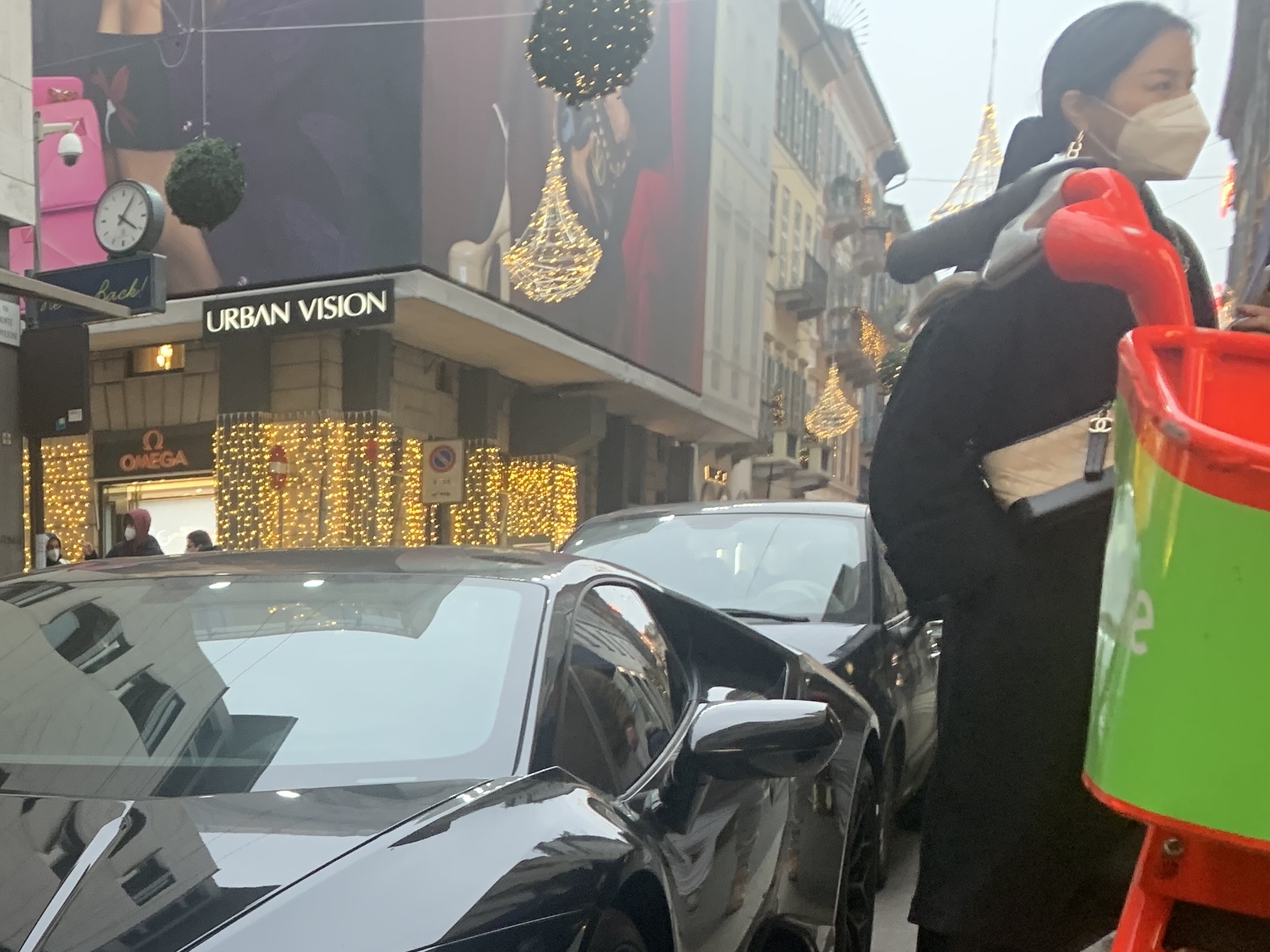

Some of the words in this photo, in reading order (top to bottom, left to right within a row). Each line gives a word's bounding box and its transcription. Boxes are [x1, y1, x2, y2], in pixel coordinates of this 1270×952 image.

[206, 301, 291, 333] URBAN
[298, 290, 387, 322] VISION
[119, 449, 188, 472] OMEGA
